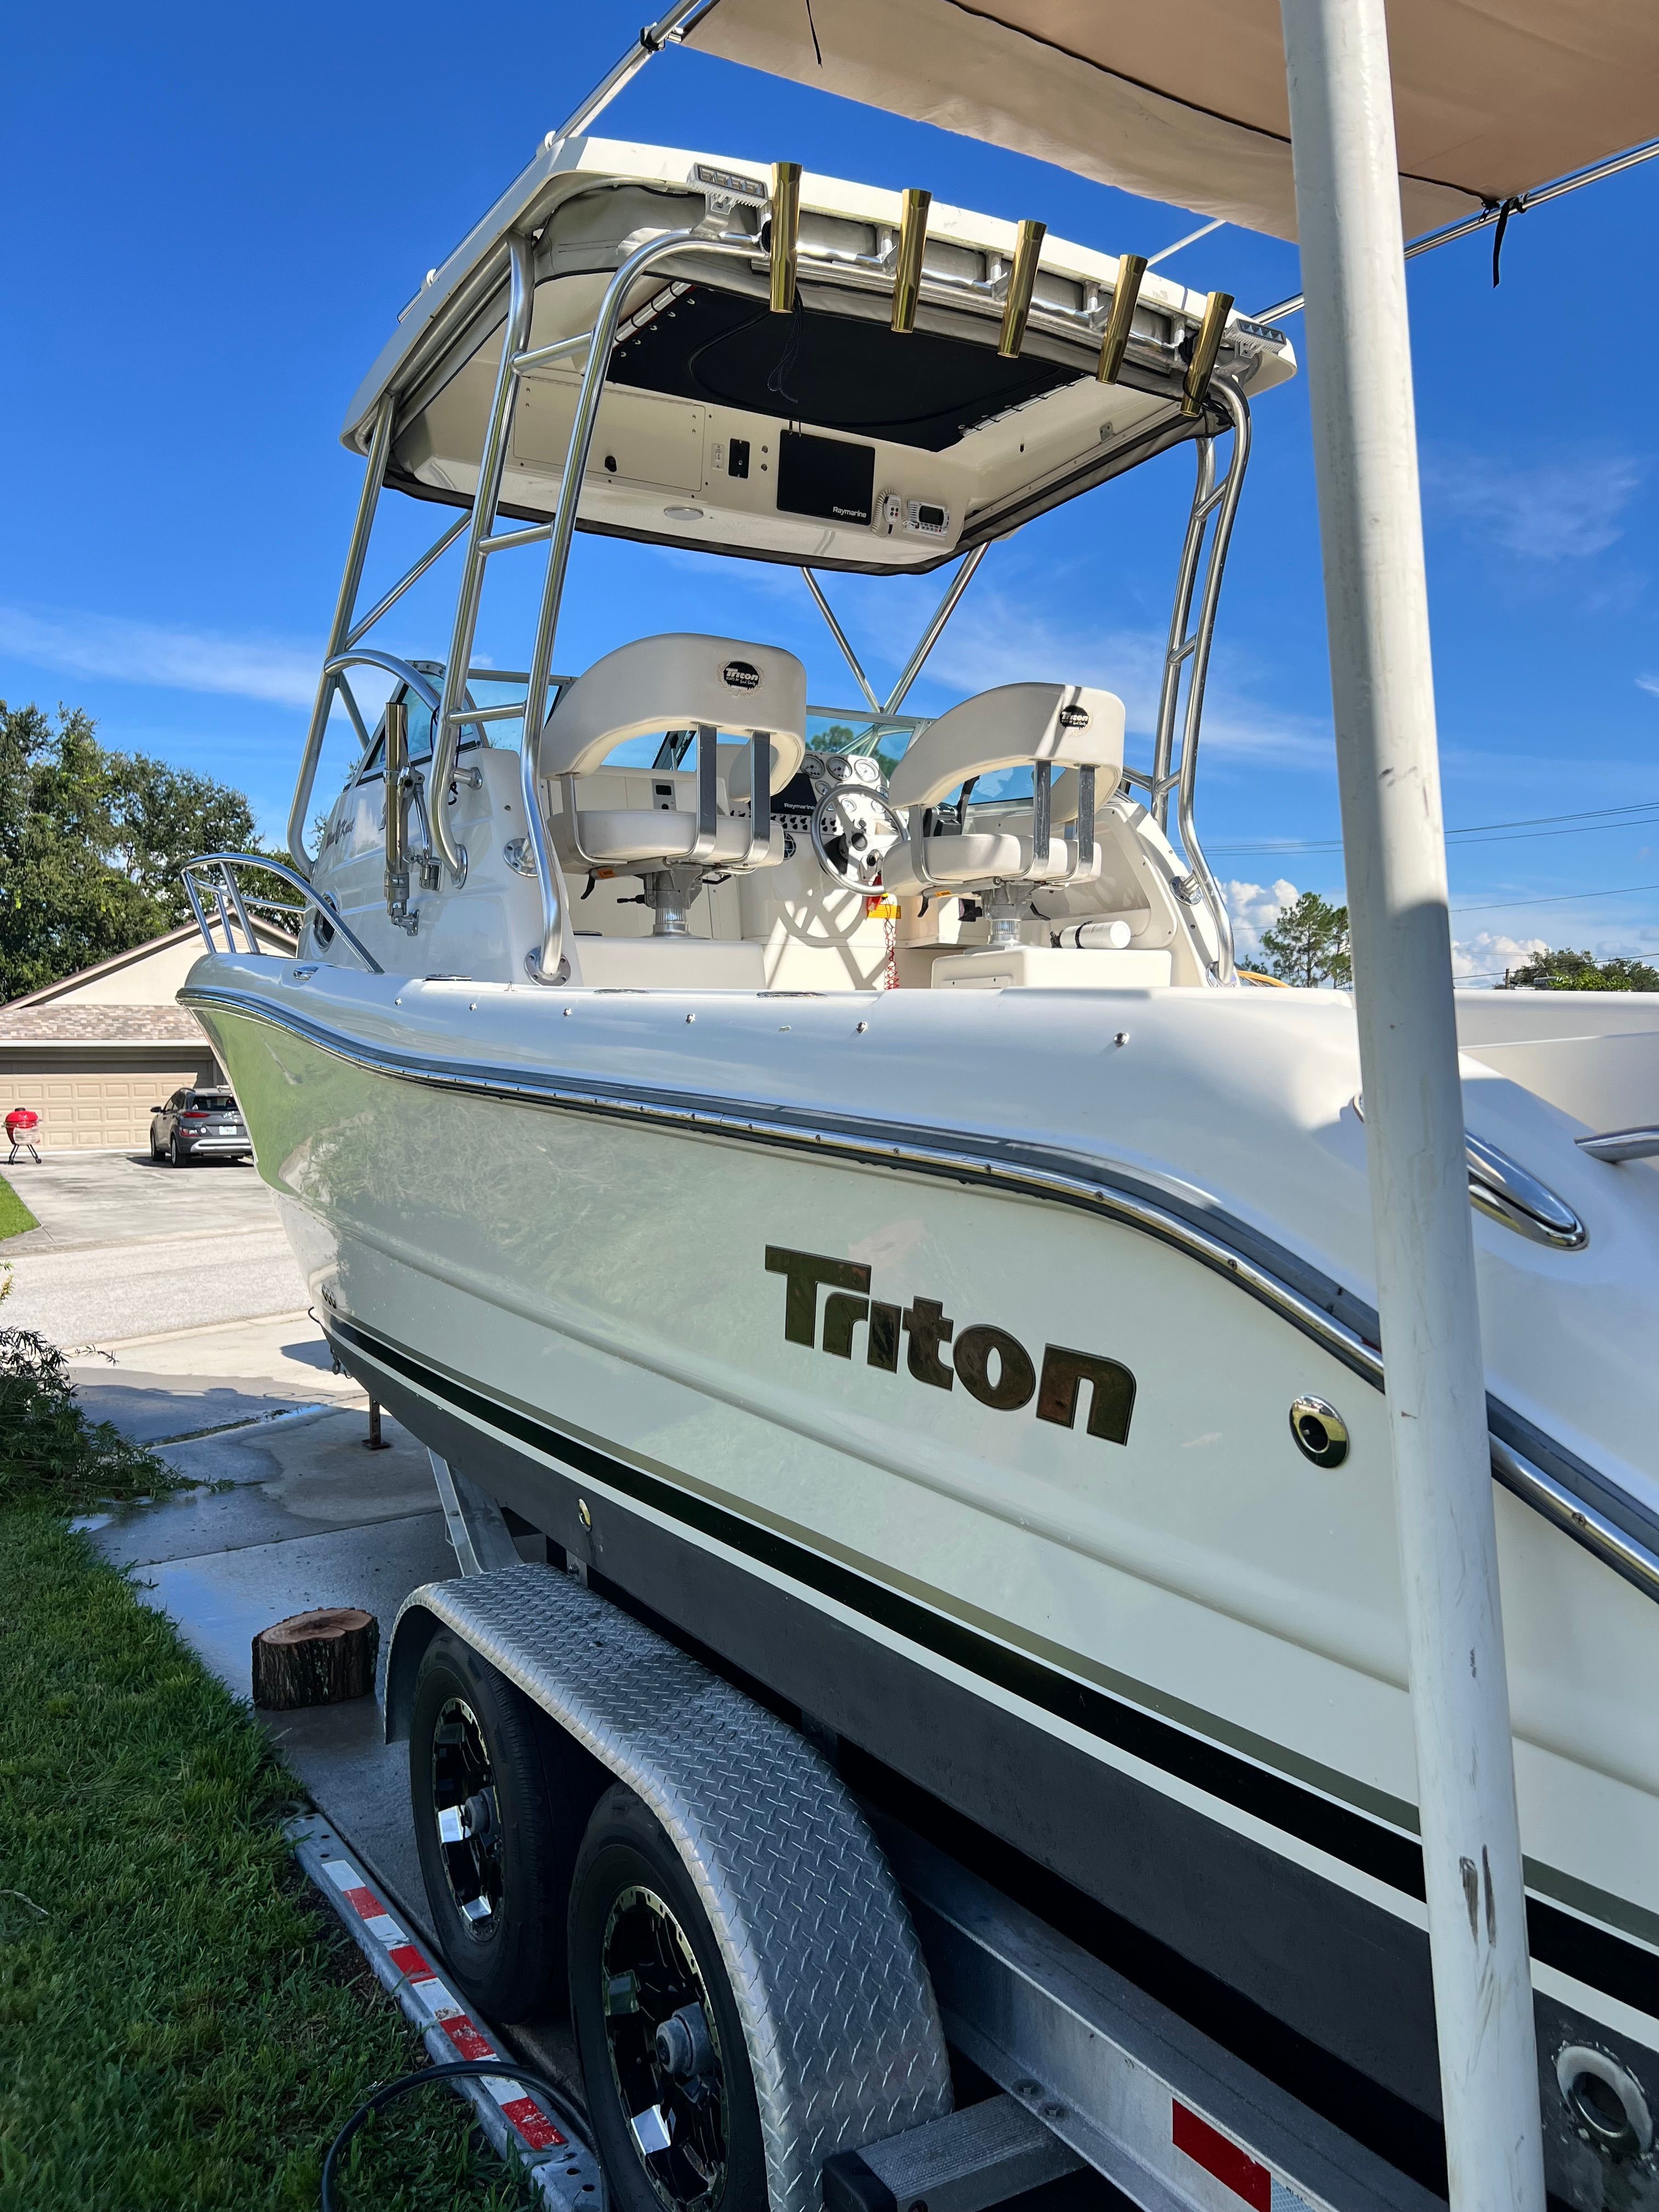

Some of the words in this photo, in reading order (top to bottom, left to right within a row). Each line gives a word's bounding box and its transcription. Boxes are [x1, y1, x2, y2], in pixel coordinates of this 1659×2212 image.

[833, 506, 866, 518] Raymarine
[726, 667, 759, 681] Triton
[765, 1244, 1136, 1446] Triton
